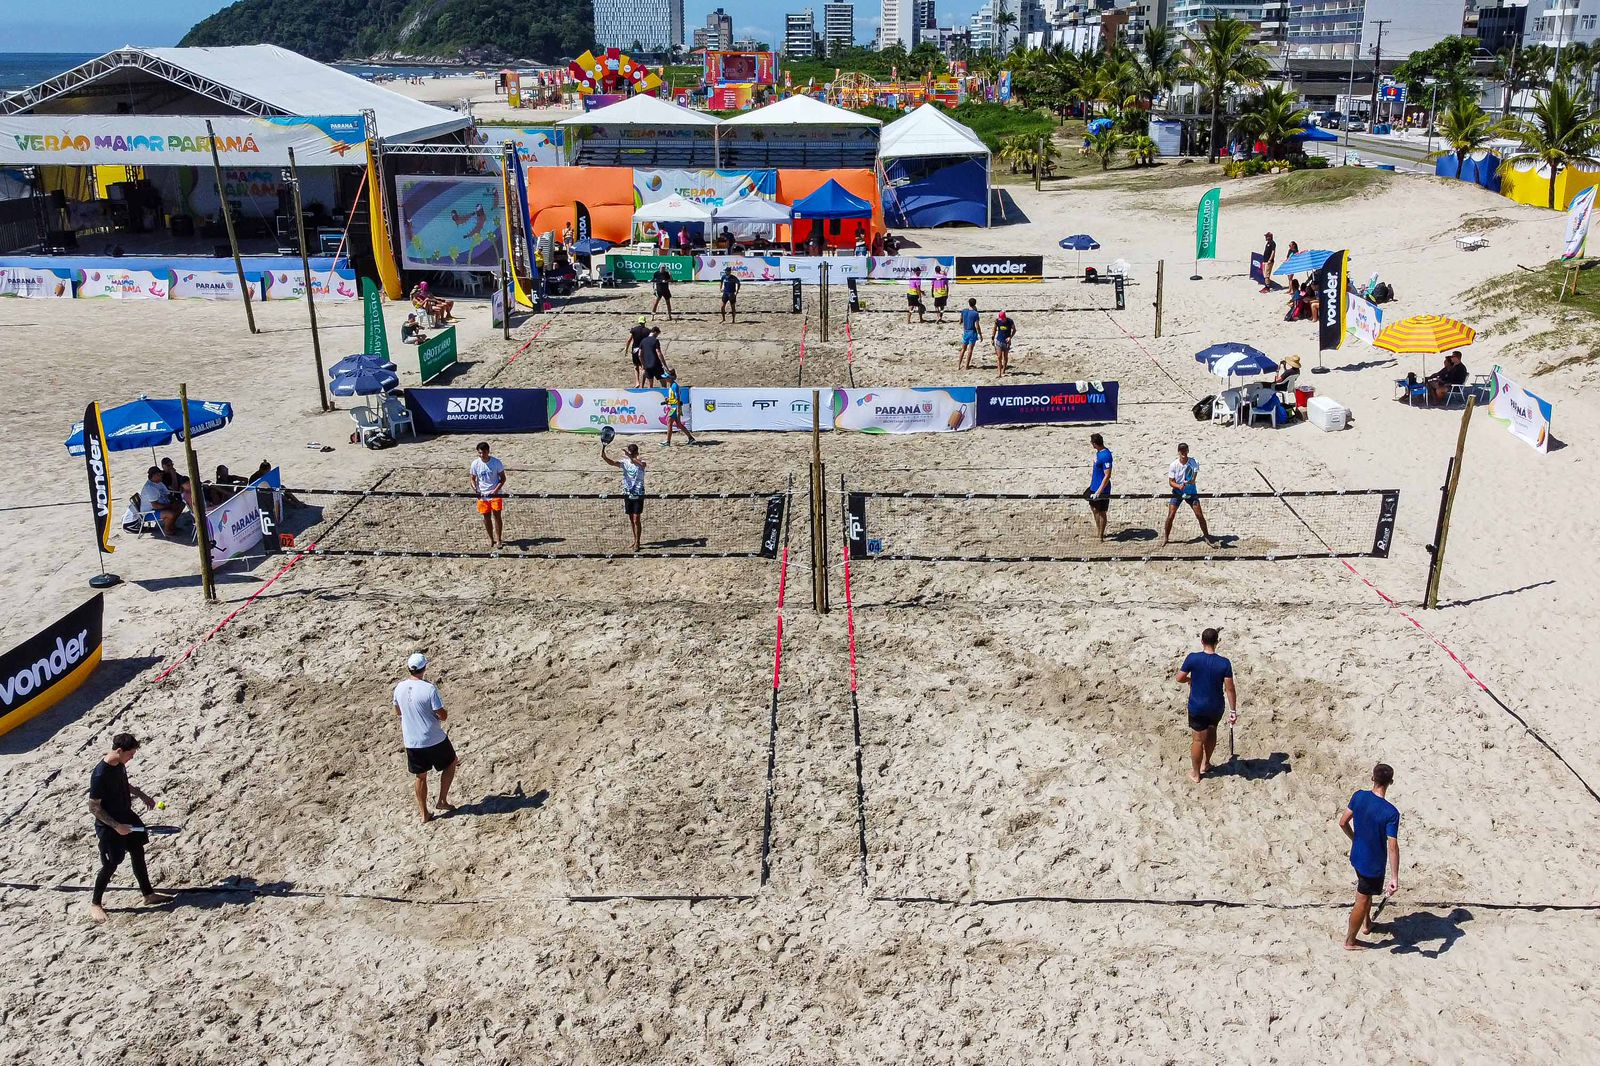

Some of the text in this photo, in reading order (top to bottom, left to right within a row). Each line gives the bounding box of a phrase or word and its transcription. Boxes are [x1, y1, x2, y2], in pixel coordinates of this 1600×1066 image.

[94, 135, 164, 151] MAIOR
[168, 133, 260, 152] PARANÁ
[467, 397, 504, 412] BRB
[875, 404, 921, 414] PARANÁ
[231, 506, 260, 535] PARANÁ
[281, 537, 293, 547] 02
[868, 543, 881, 552] 04
